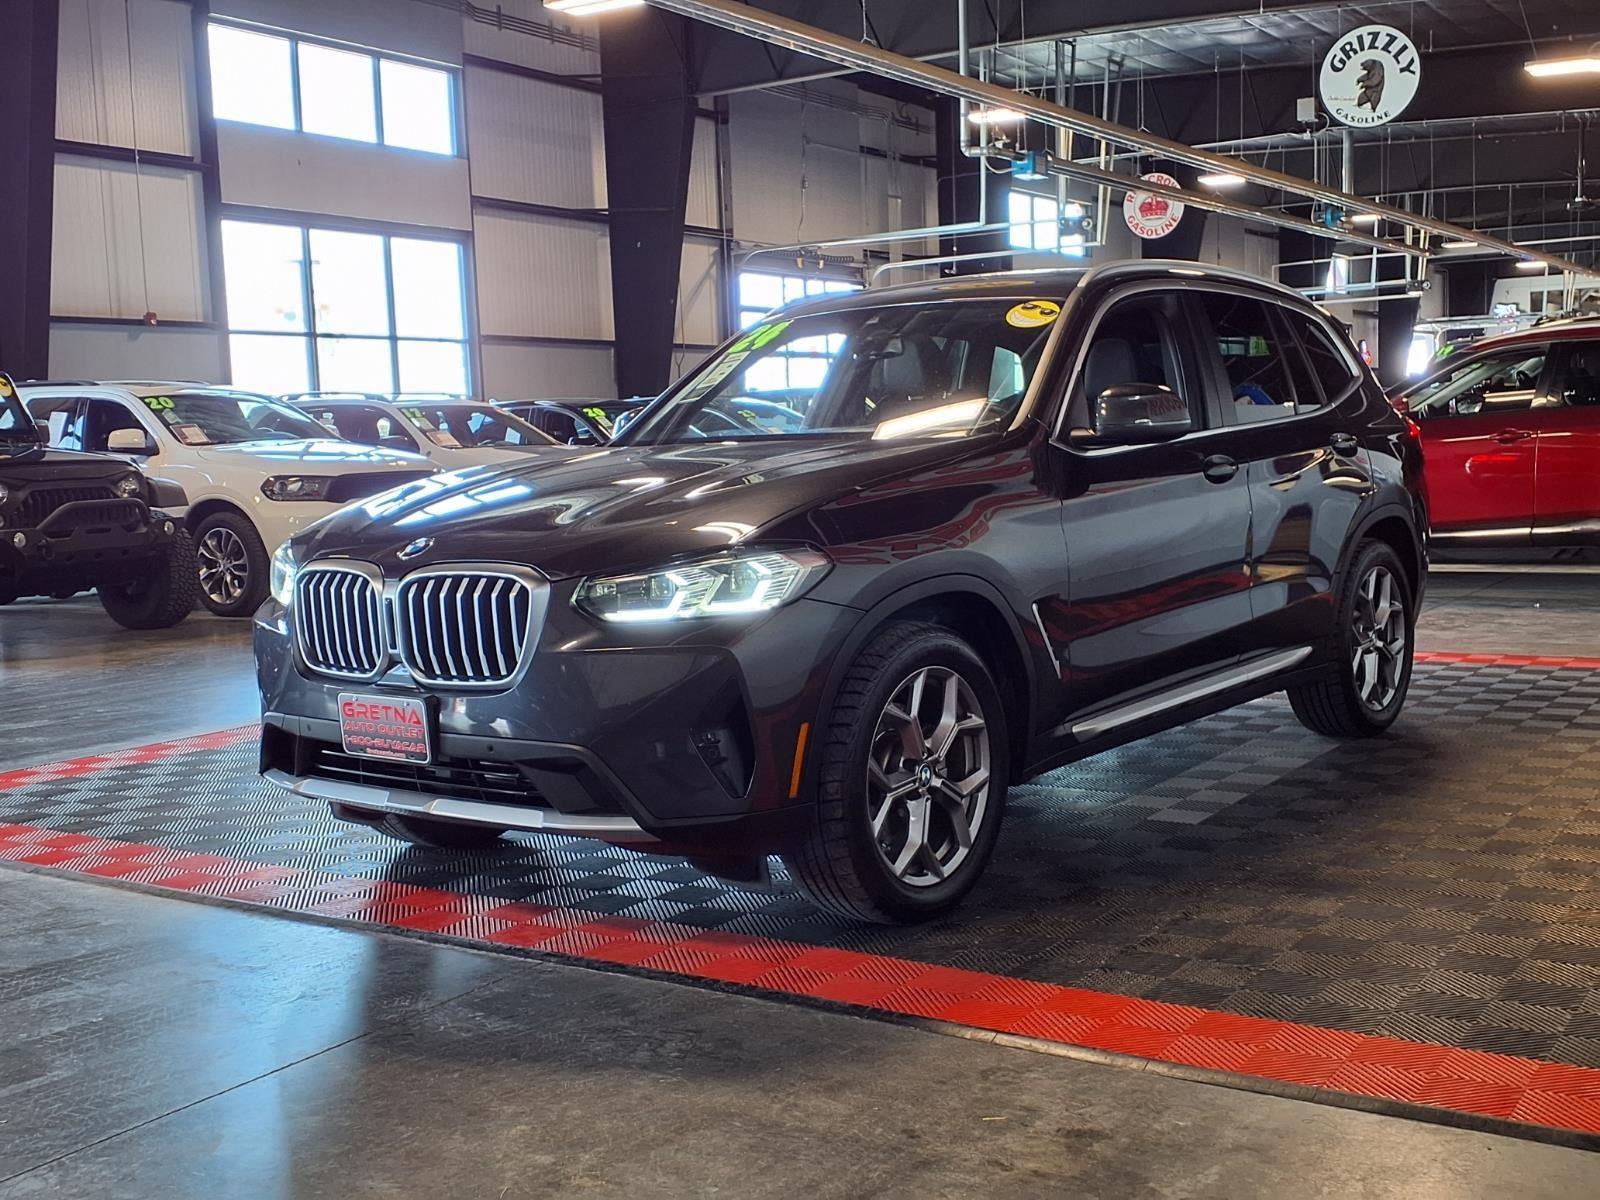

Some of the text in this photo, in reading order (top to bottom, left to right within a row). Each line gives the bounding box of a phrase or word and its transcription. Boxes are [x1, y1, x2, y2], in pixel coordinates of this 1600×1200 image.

[1329, 31, 1416, 76] GRIZZLY
[1335, 107, 1391, 124] GASOLINE
[1148, 175, 1177, 187] CRO
[1127, 213, 1179, 237] GASOLINE
[144, 396, 175, 409] 20
[582, 407, 606, 417] 20
[342, 702, 422, 725] GRETNA
[344, 720, 424, 739] AUTO OUTLET
